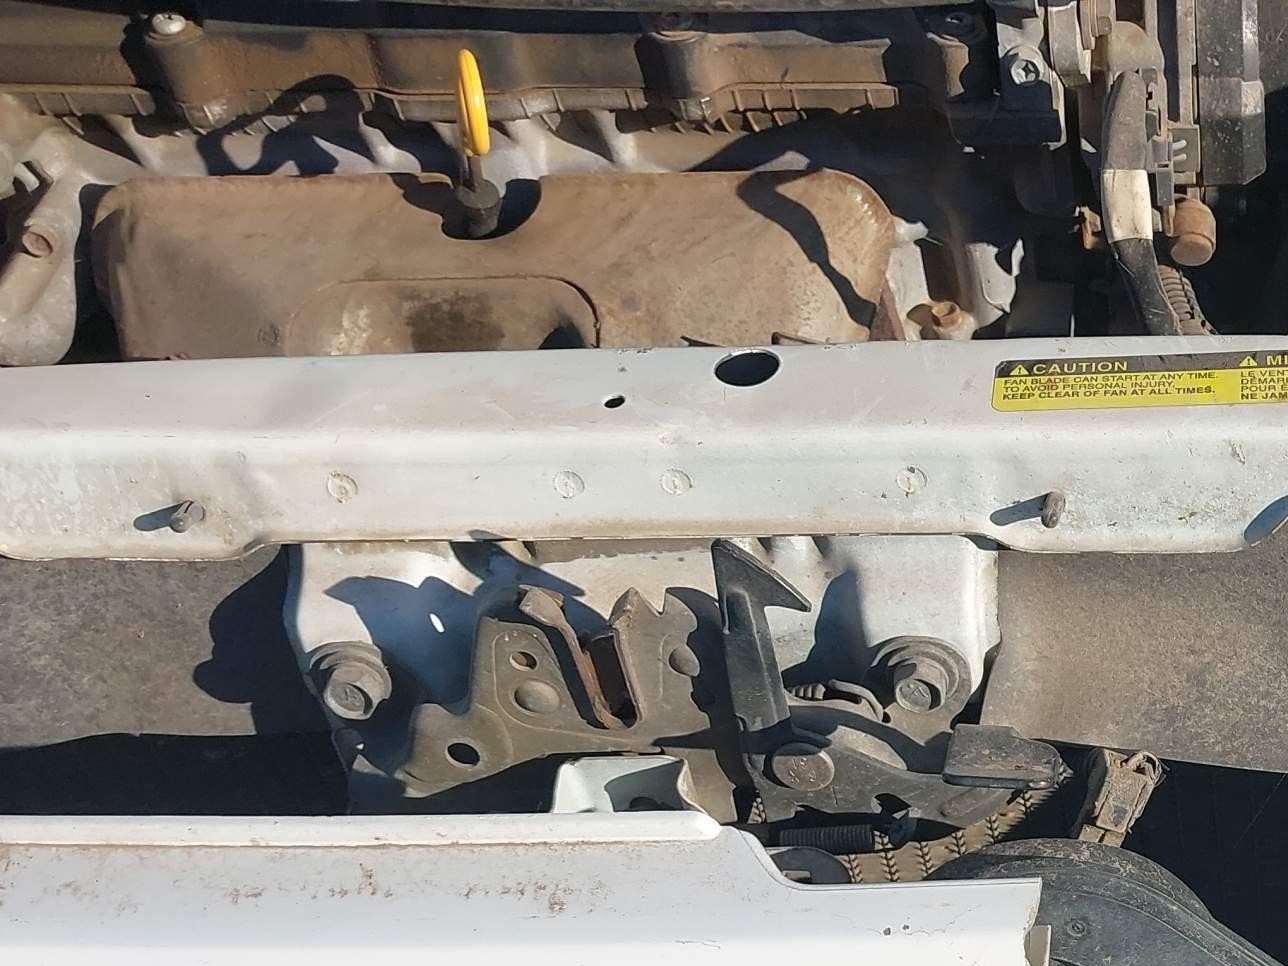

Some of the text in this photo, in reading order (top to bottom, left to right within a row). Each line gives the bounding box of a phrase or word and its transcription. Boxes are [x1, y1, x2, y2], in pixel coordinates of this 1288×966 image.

[1033, 361, 1128, 375] CAUTION
[1004, 371, 1219, 386] FAN BLADE CAN START AT ANY TIME.
[1240, 370, 1255, 378] LE
[1002, 385, 1216, 401] KEEP CLEAR OF FAN AT ALL TIMES.
[1004, 385, 1020, 393] TO
[1021, 383, 1059, 392] AVOID
[1062, 382, 1128, 391] PERSONAL
[1240, 384, 1277, 393] POUR
[1240, 391, 1258, 400] NE
